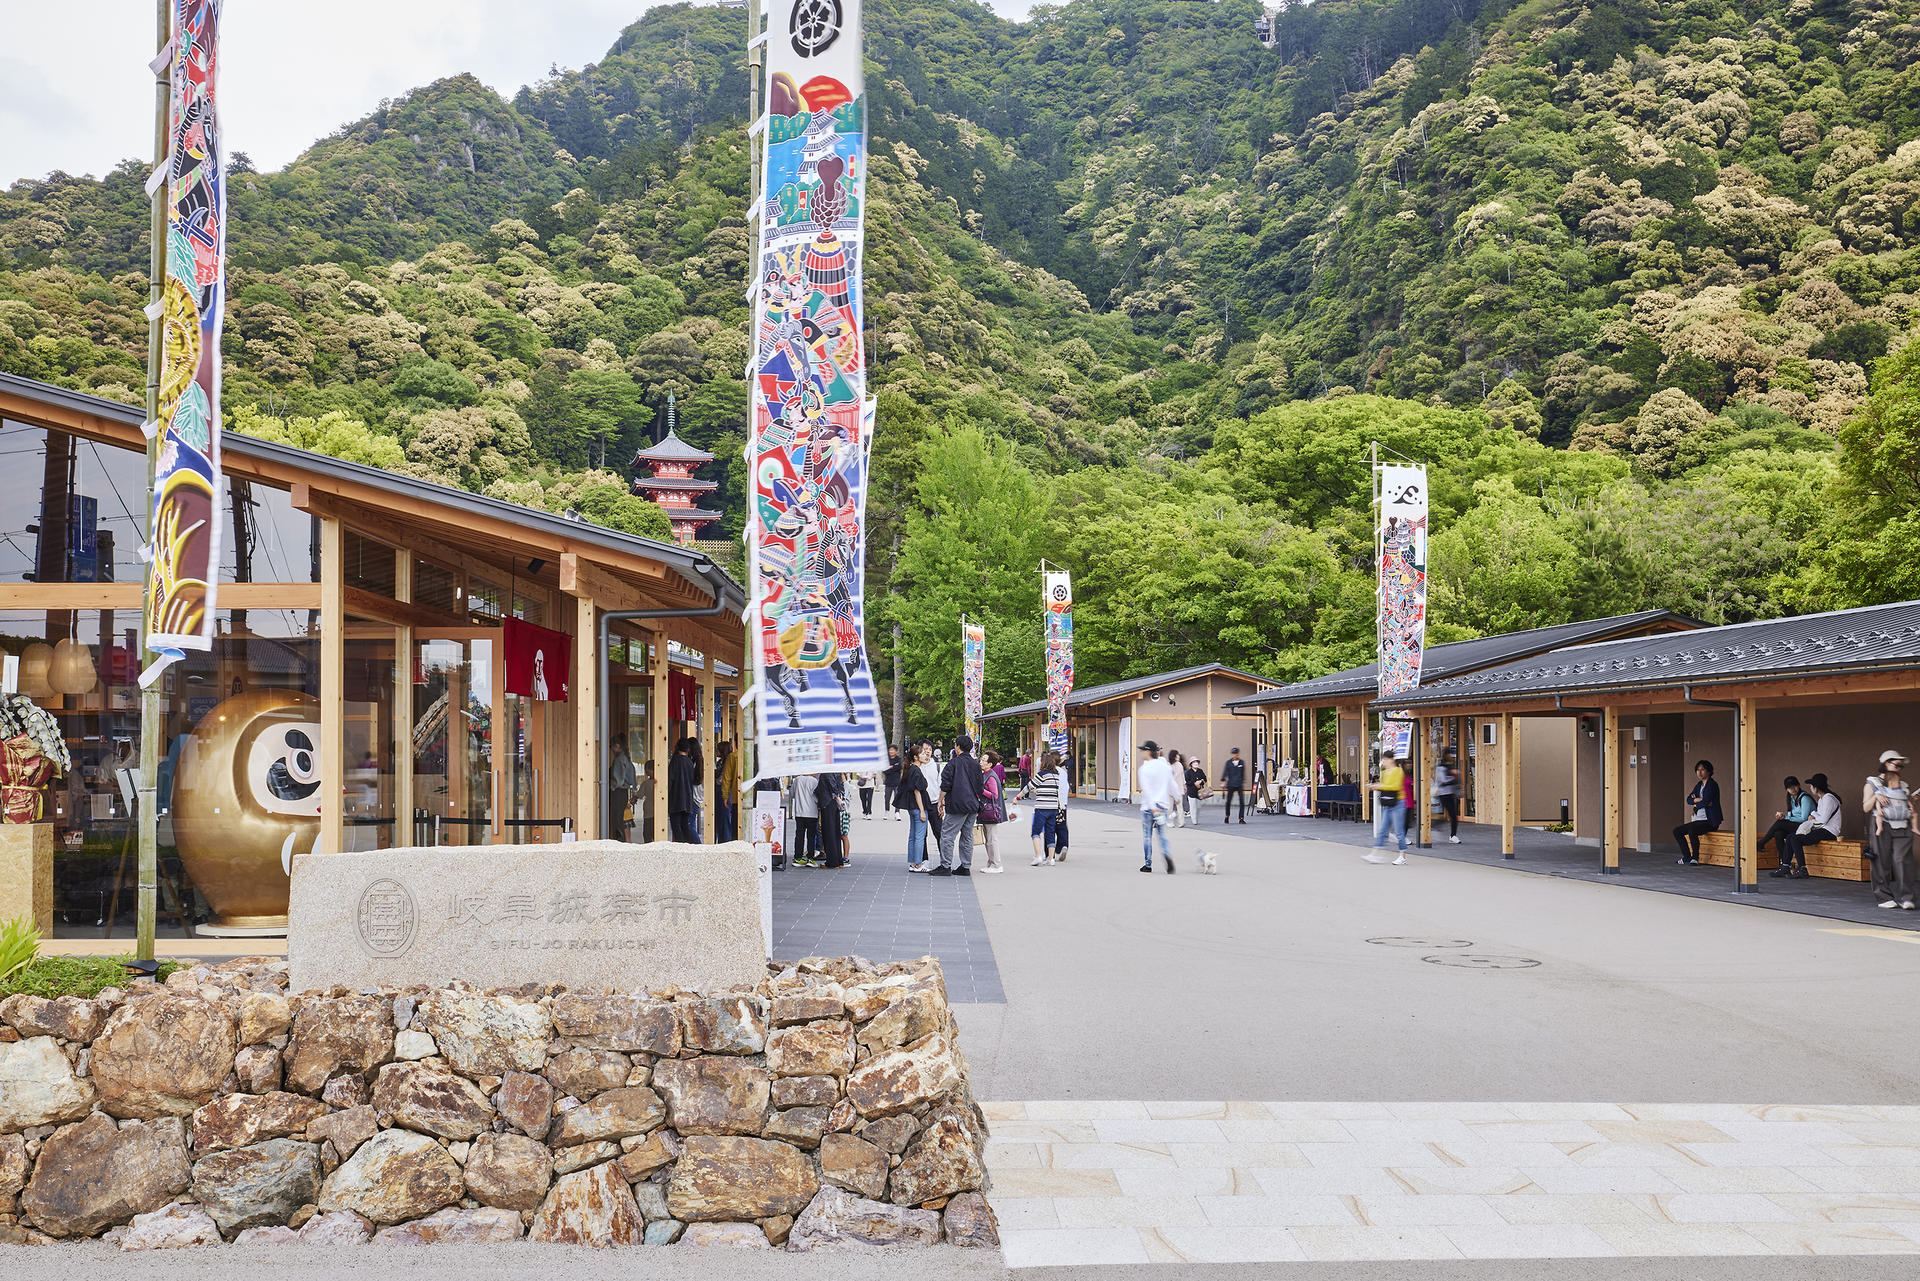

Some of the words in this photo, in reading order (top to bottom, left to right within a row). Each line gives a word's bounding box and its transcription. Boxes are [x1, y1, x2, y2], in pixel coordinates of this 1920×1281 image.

[446, 888, 698, 927] 岐阜城楽市
[491, 939, 563, 951] GIFU-JO
[570, 939, 656, 951] RAKUICHI
